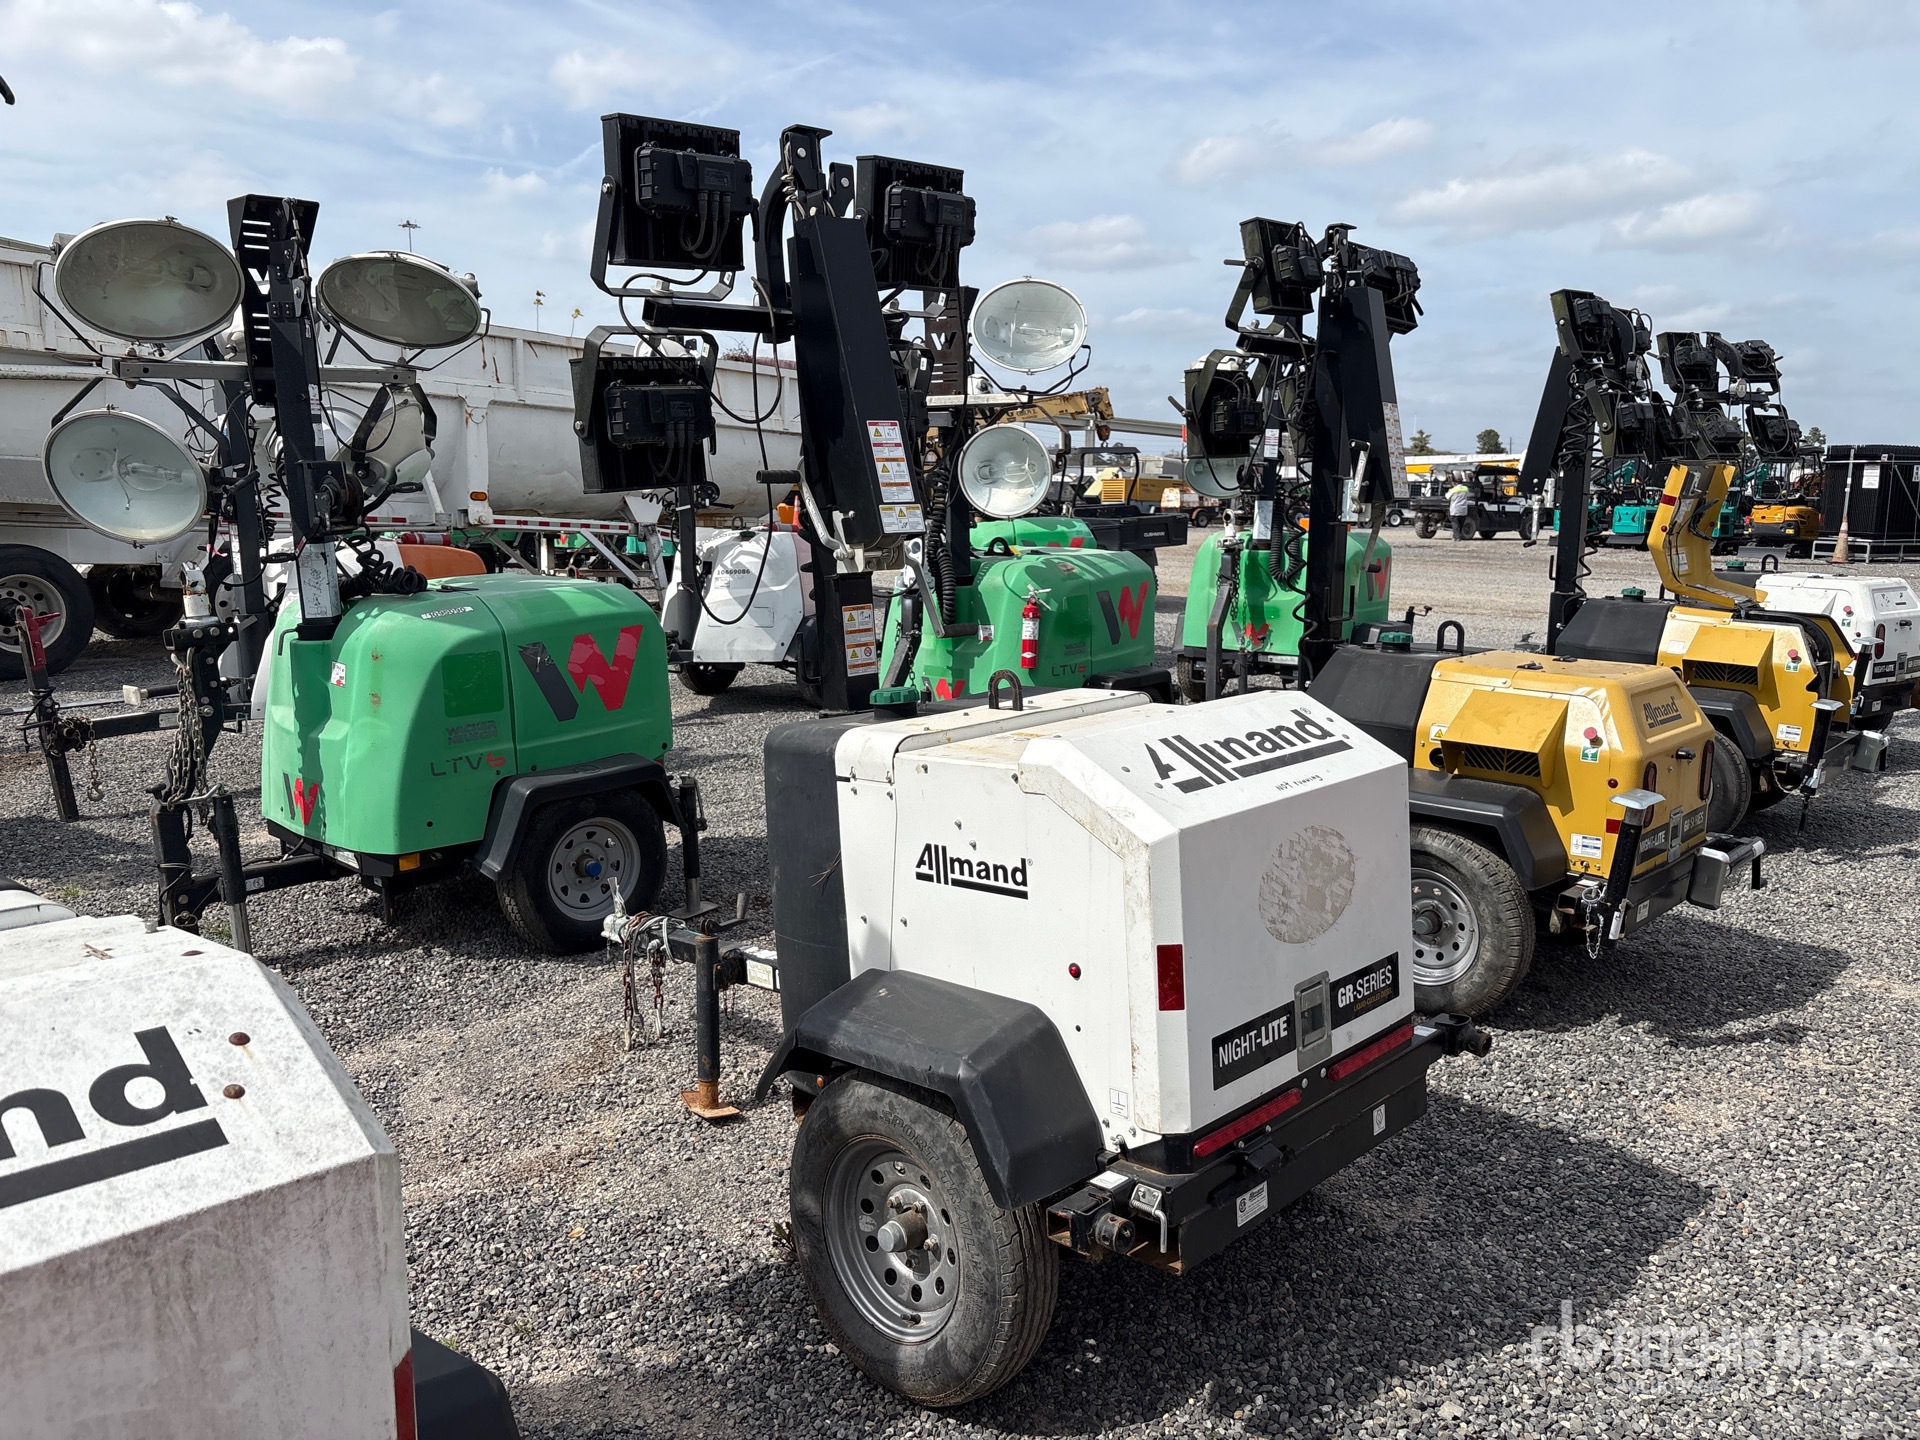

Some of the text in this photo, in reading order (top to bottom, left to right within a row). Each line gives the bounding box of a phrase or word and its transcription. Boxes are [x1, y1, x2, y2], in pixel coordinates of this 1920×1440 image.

[1643, 697, 1680, 728] Allmand
[1145, 709, 1336, 786] Allmand
[916, 843, 1028, 888] Allmand
[1337, 965, 1393, 1008] GR-SERIES
[1218, 1015, 1289, 1067] NIGHT-LITE
[880, 1110, 939, 1161] SPORT
